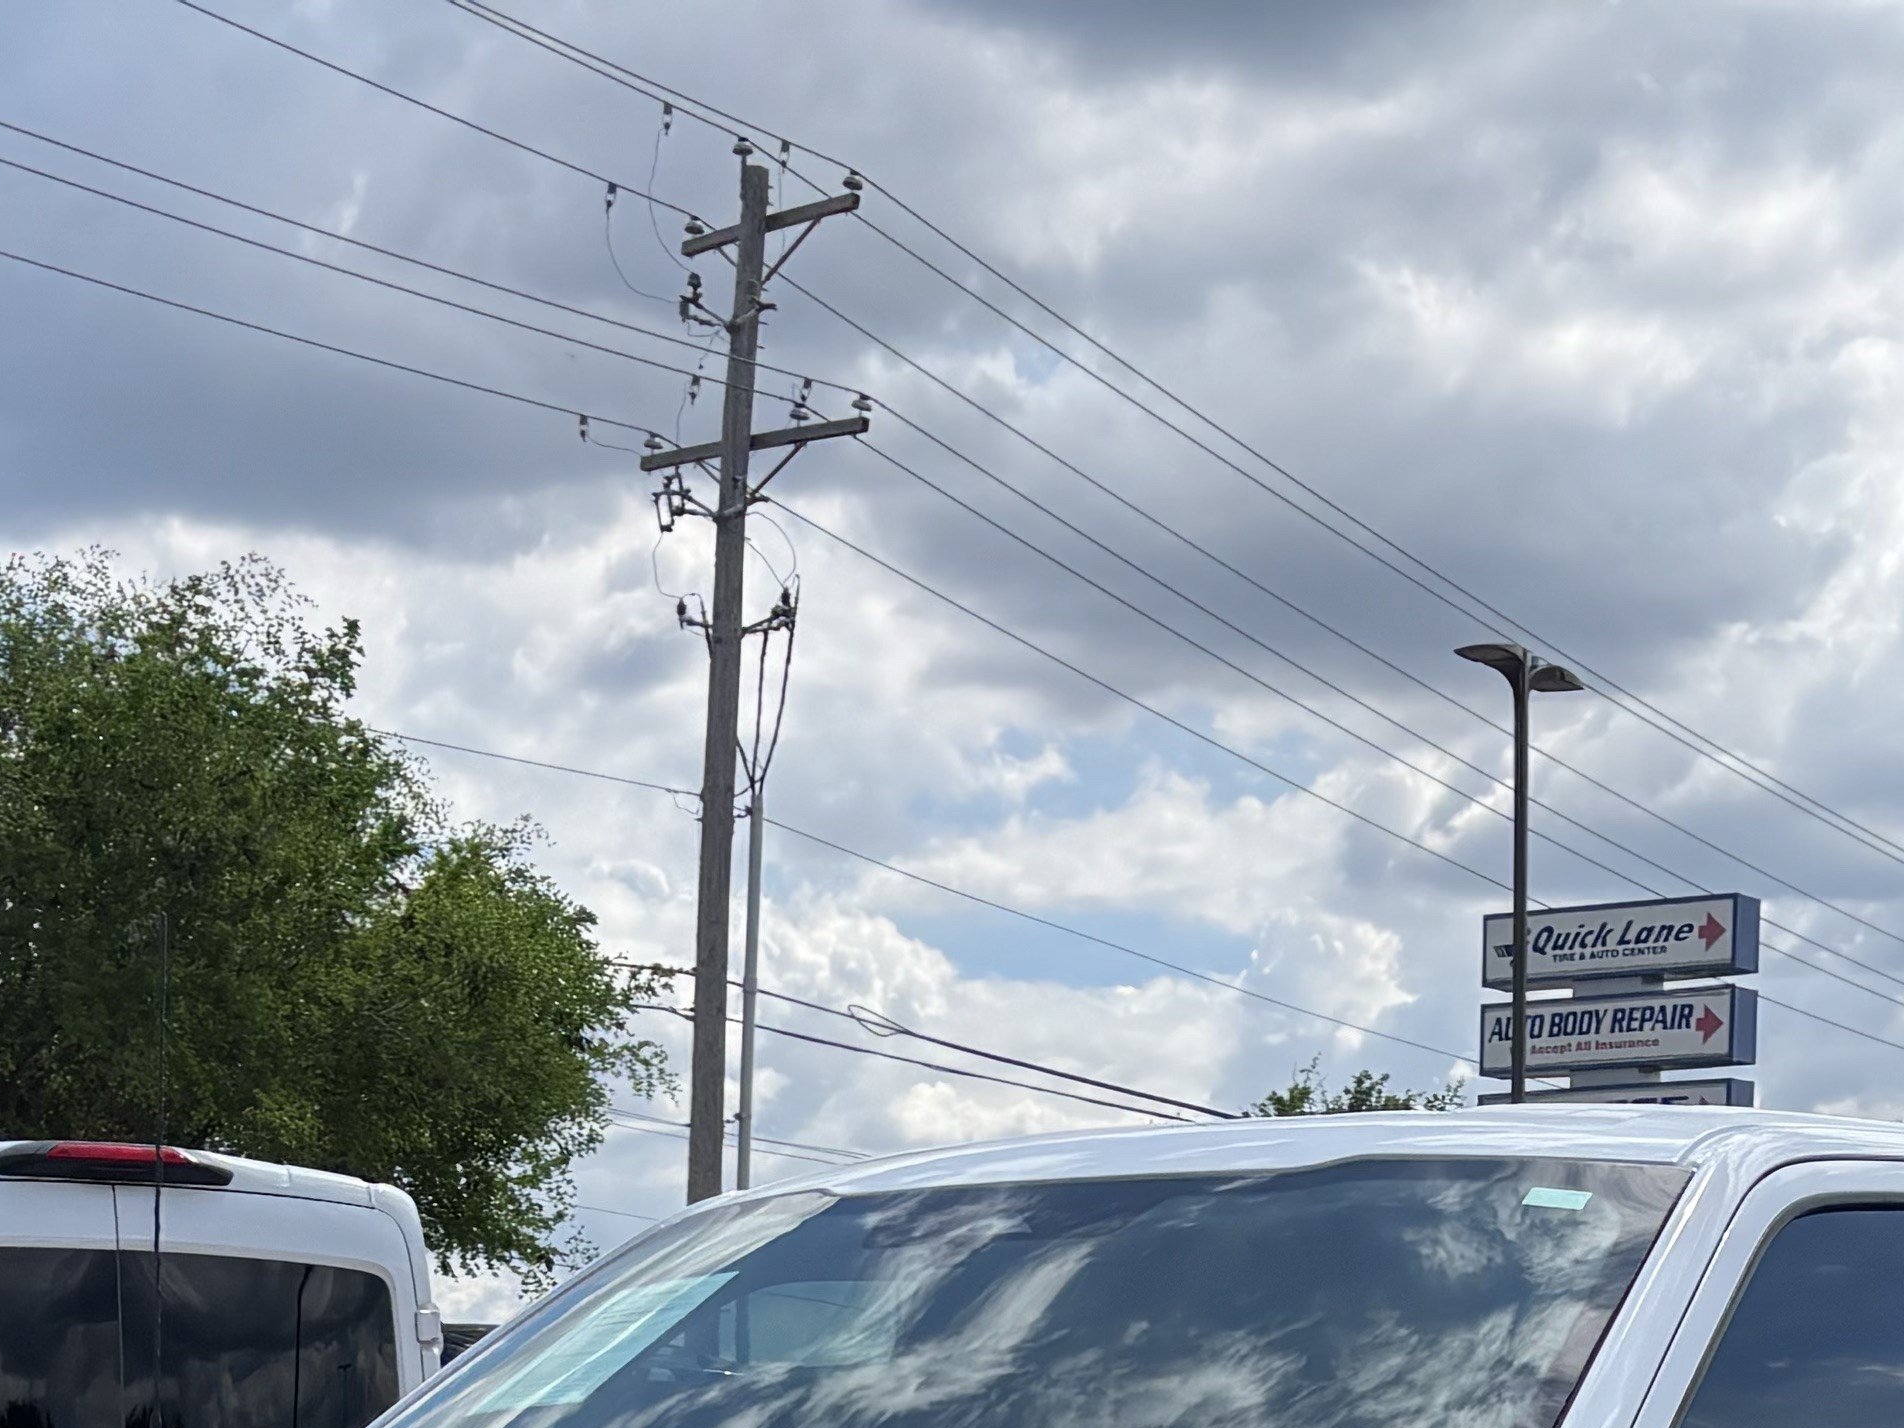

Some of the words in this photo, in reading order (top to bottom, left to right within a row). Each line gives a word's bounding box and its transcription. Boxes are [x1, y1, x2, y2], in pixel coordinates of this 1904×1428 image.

[1532, 921, 1614, 955] Quick
[1617, 919, 1695, 947] Lane
[1553, 953, 1575, 963] TIRE
[1589, 948, 1619, 961] AUTO
[1622, 945, 1668, 958] CENTER
[1548, 1008, 1608, 1038] BODY
[1610, 1003, 1695, 1034] REPAIR
[1595, 1037, 1659, 1051] Insurance
